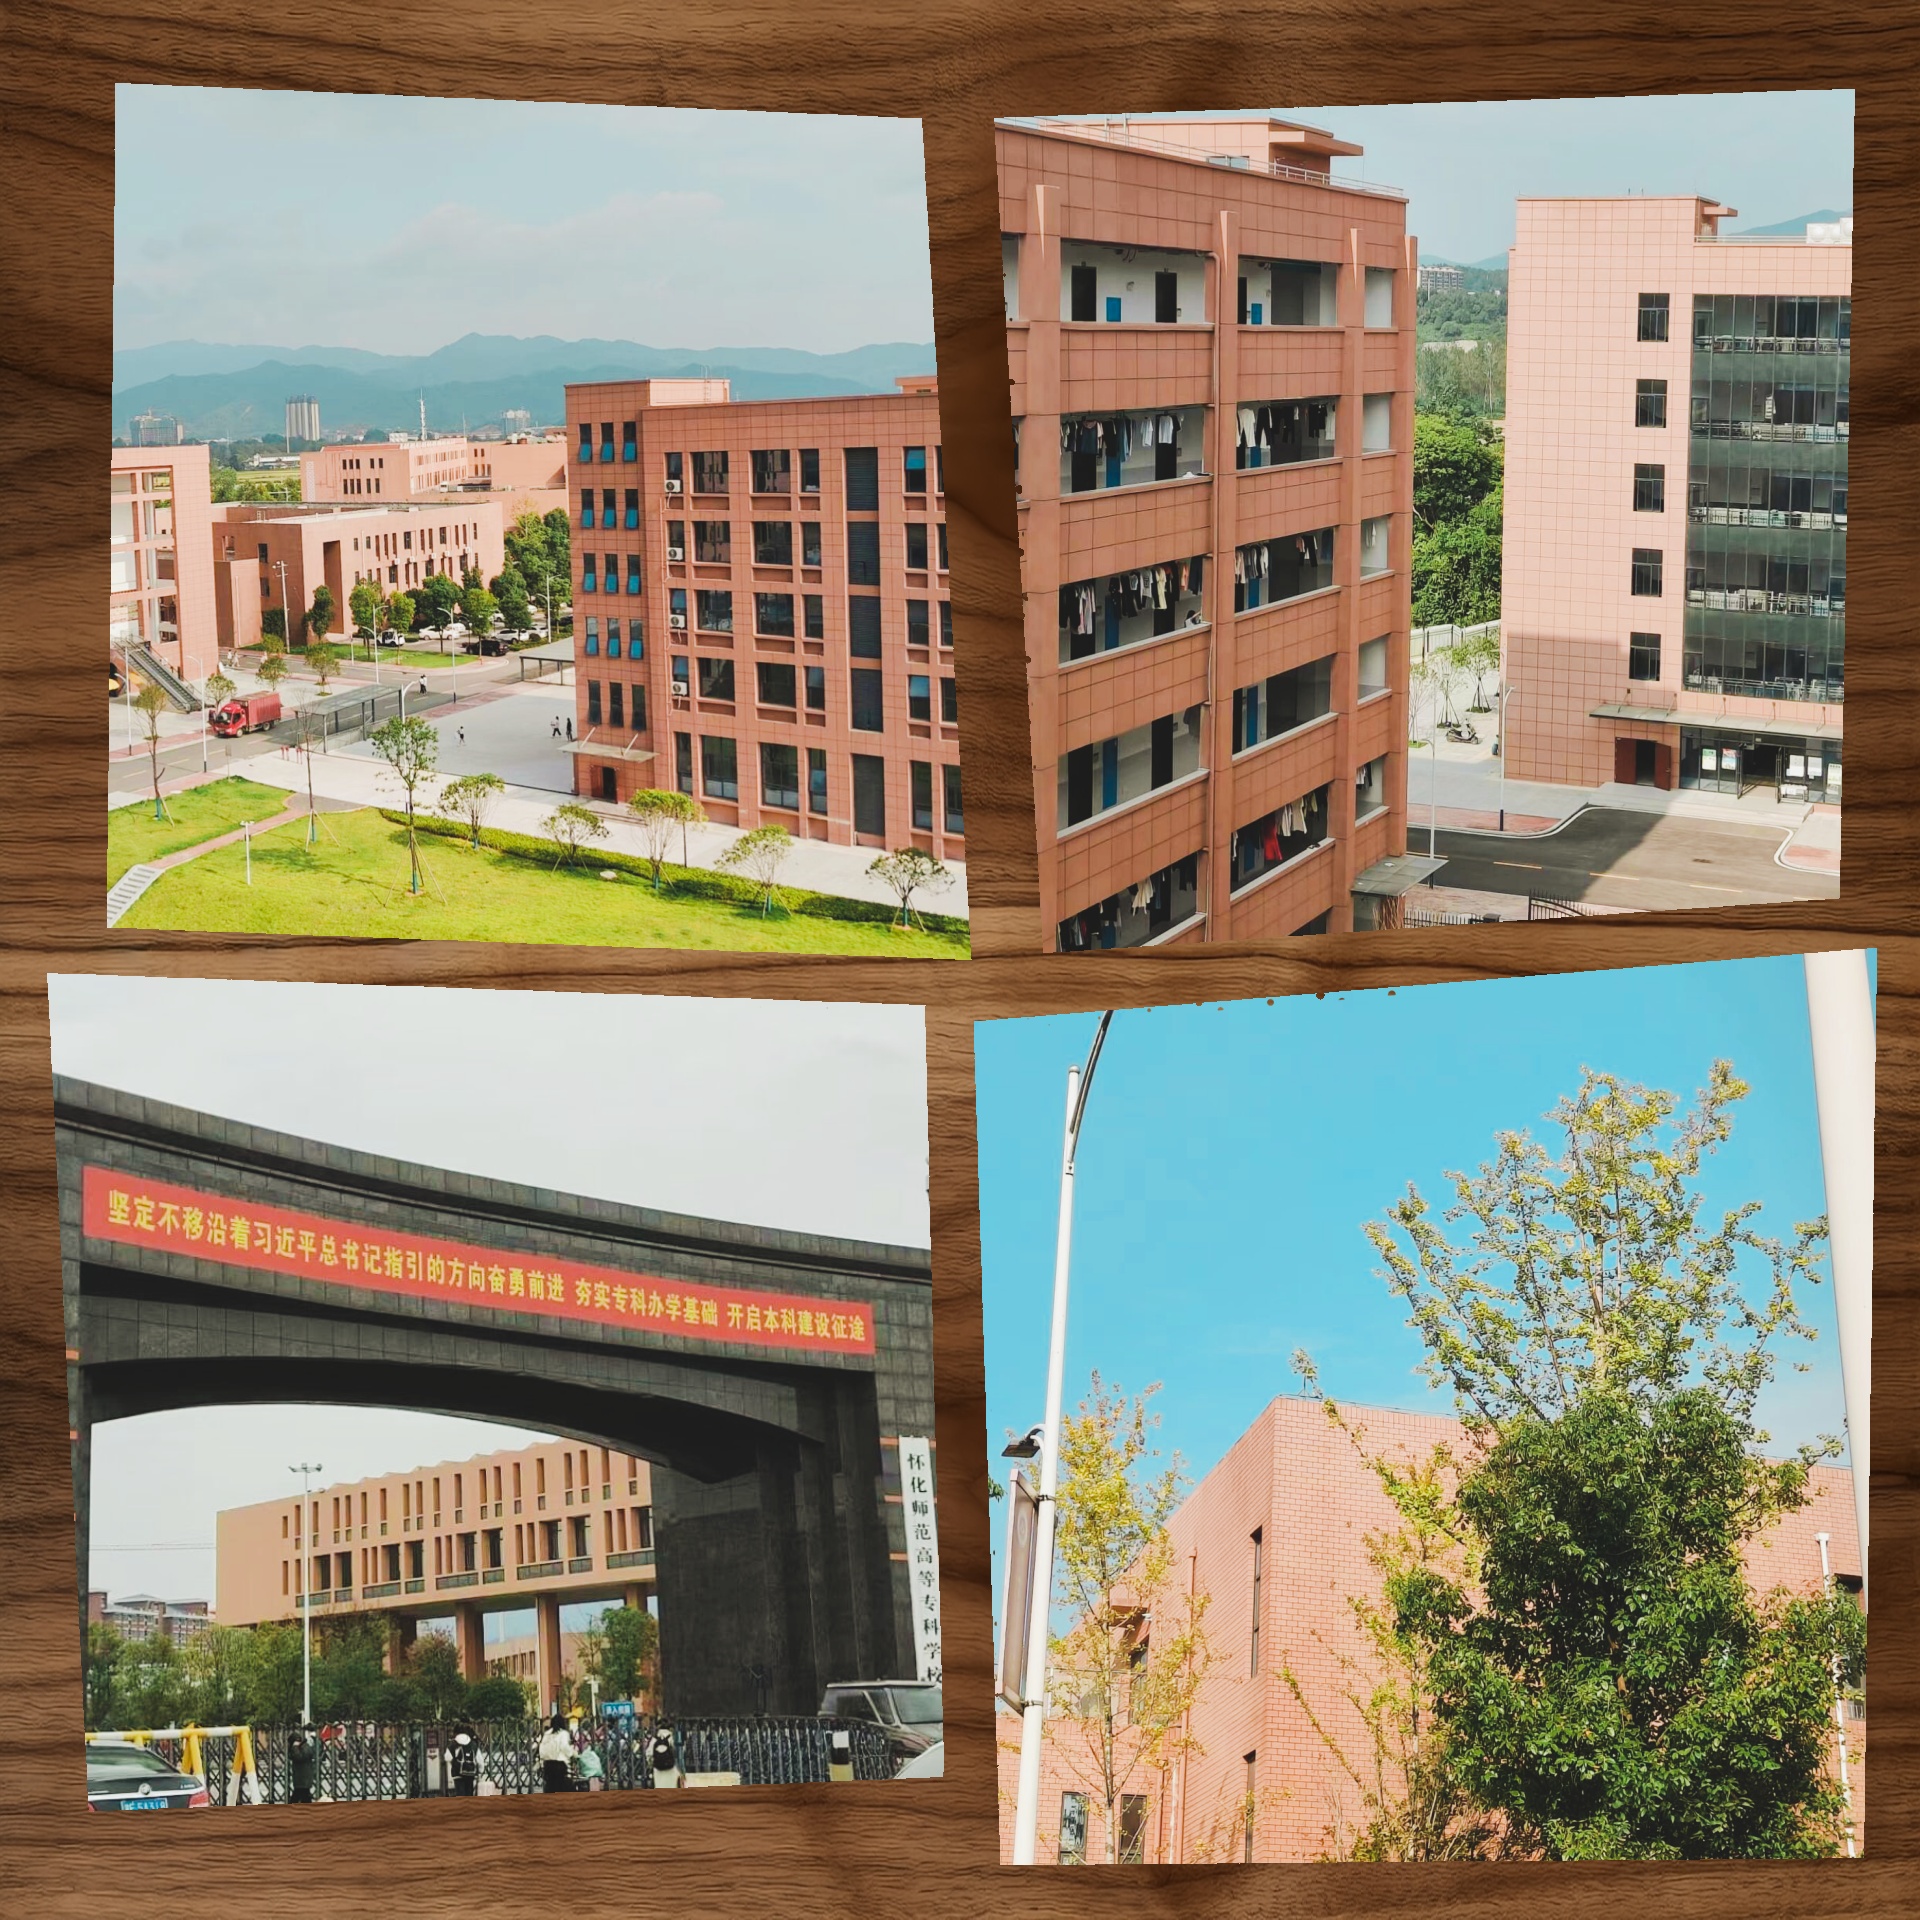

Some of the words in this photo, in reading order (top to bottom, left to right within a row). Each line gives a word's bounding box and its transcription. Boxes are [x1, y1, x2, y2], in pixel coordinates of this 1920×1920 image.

[108, 1189, 564, 1302] 坚定不移沿着习近平总书记指引的方向奋勇前进
[575, 1277, 719, 1327] 夯实专科办学基础
[726, 1304, 866, 1342] 开启本科建设征途
